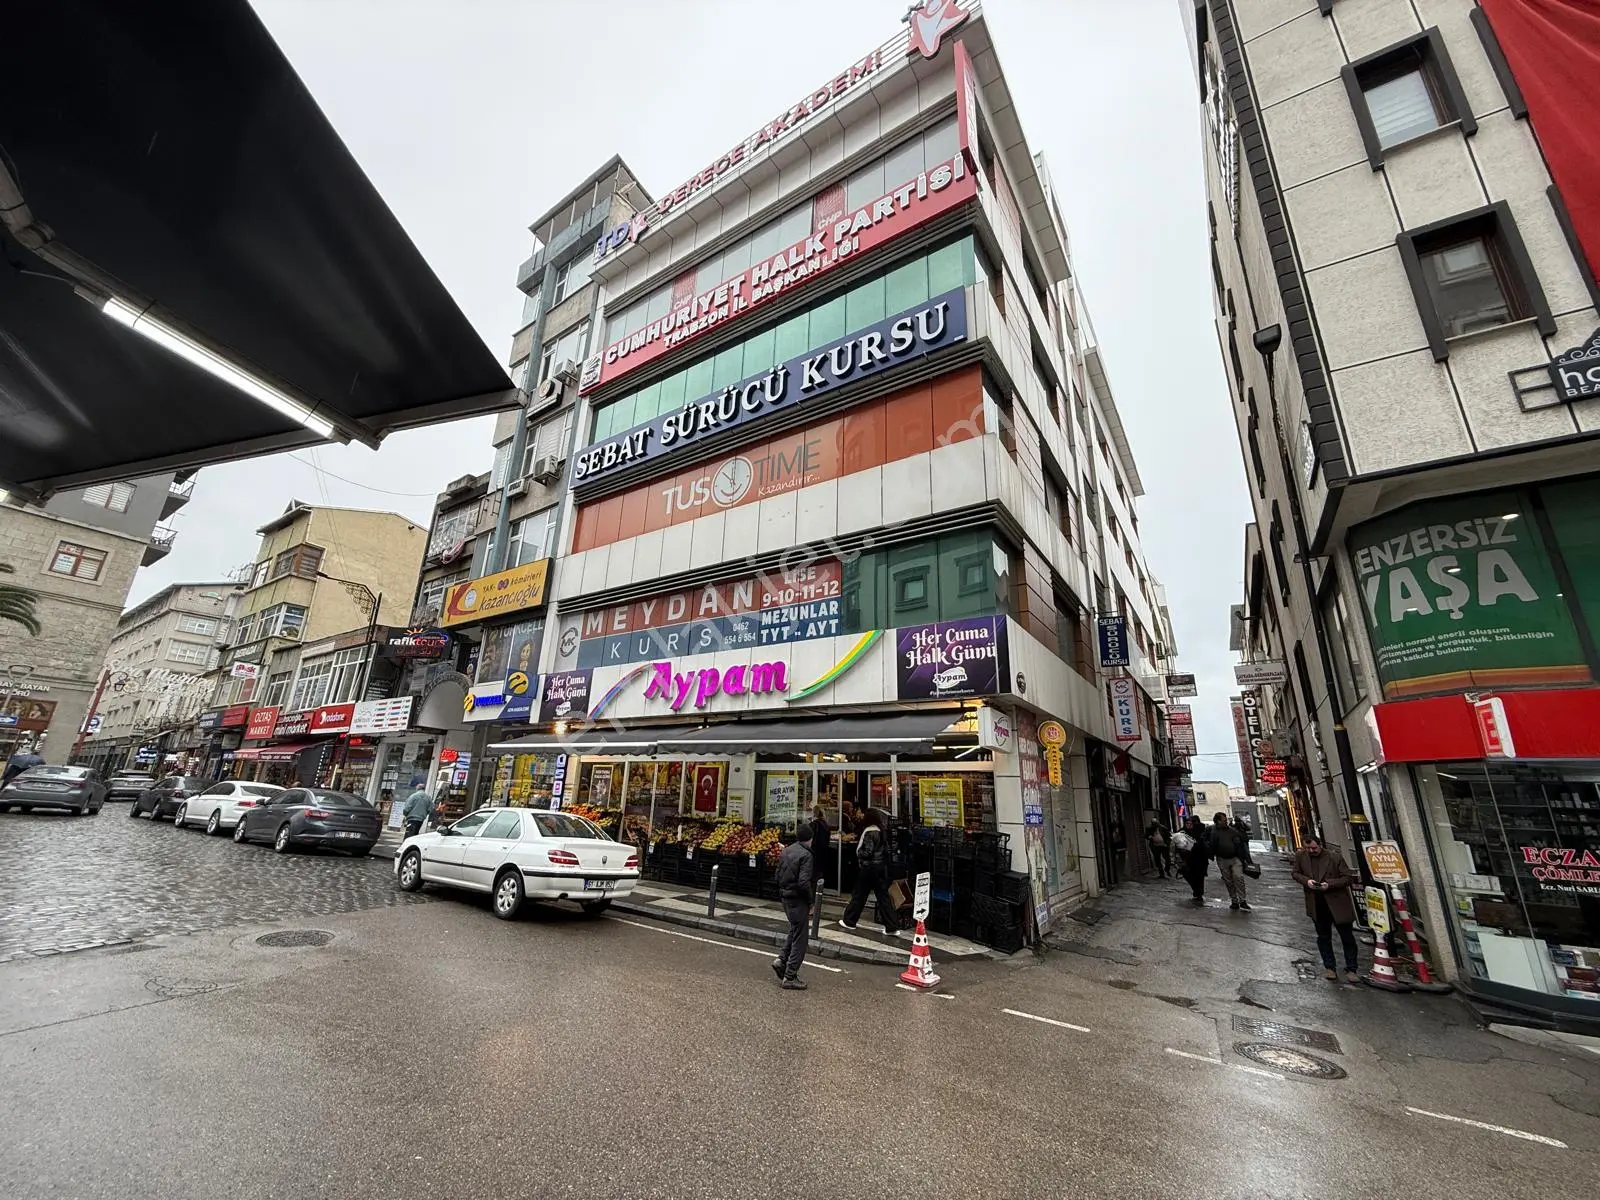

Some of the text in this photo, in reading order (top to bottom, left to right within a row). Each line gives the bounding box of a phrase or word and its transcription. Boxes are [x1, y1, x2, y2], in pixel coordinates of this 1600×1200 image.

[657, 144, 745, 214] DERECE
[605, 152, 964, 364] CUMHURİYET HALK PARTİSİ
[663, 236, 859, 348] TRABZON İL BAŞKANLIĞI
[574, 301, 950, 479] SEBAT SÜRÜCÜ KURSU
[662, 439, 821, 515] TUS TIME
[1355, 516, 1517, 576] ENZERSİZ
[479, 584, 541, 612] kazancıoğlu
[762, 580, 839, 607] 9-10-11-12
[1361, 549, 1539, 628] YAŞA
[585, 580, 754, 636] MEYDAN
[762, 600, 839, 626] MEZUNLAR
[732, 622, 749, 632] 0462
[760, 626, 790, 643] TYT
[805, 619, 839, 637] AYT
[912, 627, 989, 649] Her Cuma
[1405, 636, 1435, 647] normal
[1437, 631, 1466, 641] enerji
[389, 637, 446, 646] rafiktours
[610, 628, 712, 659] KURS
[1436, 645, 1477, 656] bulunur.
[905, 642, 996, 668] Halk Günü
[20, 683, 50, 691] BAYAN
[551, 675, 585, 689] Her Cuma
[643, 660, 789, 712] Aypam
[933, 673, 967, 683] Aypam
[547, 686, 587, 702] Halk Günü
[254, 710, 272, 723] ÖZTAŞ
[1118, 700, 1132, 735] KURS
[1243, 698, 1259, 735] OTEL
[249, 726, 270, 735] MARKET
[1368, 846, 1397, 854] CAM
[1520, 846, 1600, 867] ECZA
[1557, 884, 1575, 892] Nuri
